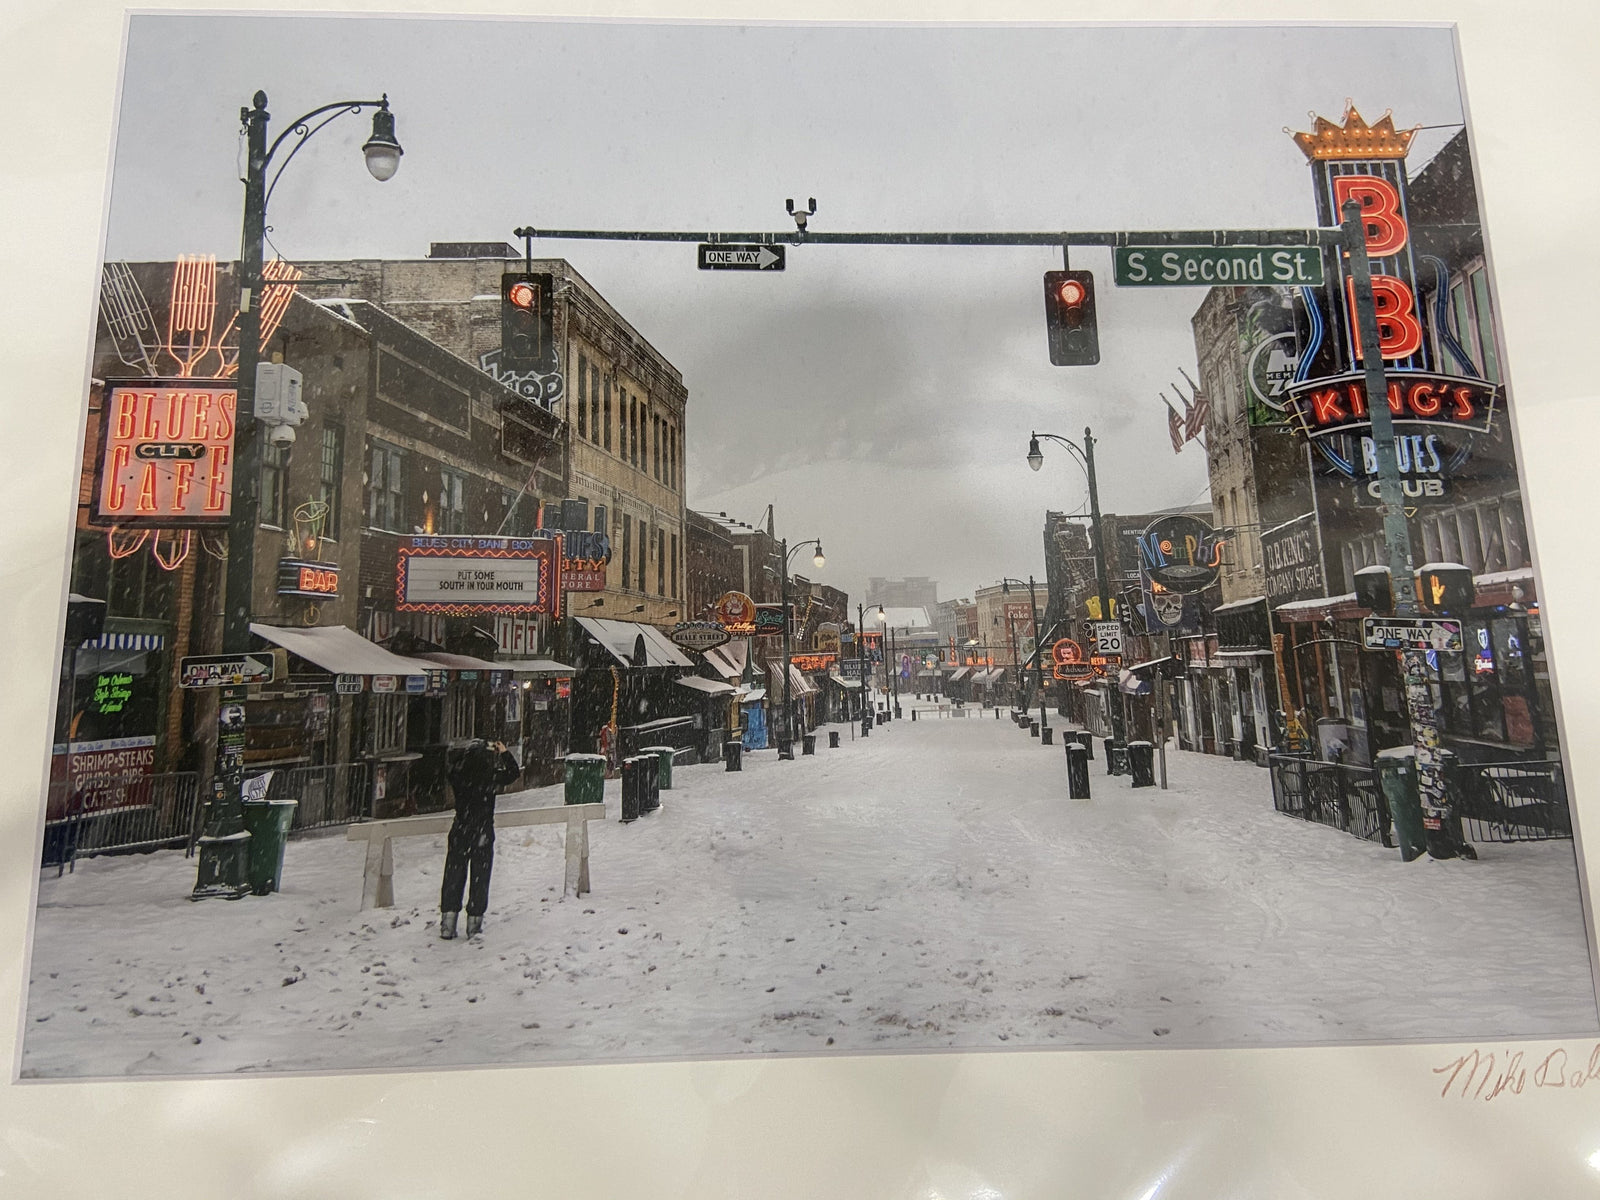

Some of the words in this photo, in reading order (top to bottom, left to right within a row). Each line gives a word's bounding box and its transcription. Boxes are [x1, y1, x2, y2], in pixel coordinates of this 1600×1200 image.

[1332, 174, 1409, 258] B
[708, 252, 732, 263] ONE
[735, 252, 760, 263] WAY
[1127, 252, 1153, 282] S.
[1160, 252, 1263, 282] Second
[1271, 252, 1313, 281] St.
[1346, 274, 1422, 361] B
[1309, 381, 1476, 424] KING'S
[113, 391, 236, 441] BLUES
[138, 444, 203, 457] CITY
[1360, 434, 1442, 475] BUES
[106, 444, 229, 512] CAFE
[1366, 479, 1446, 498] CUB
[411, 537, 448, 548] BLUES
[451, 538, 475, 548] CITY
[478, 539, 508, 549] BAND
[511, 540, 535, 550] BOX
[1136, 529, 1227, 570] Memphis
[1281, 530, 1312, 567] KING'S
[564, 558, 605, 571] ITY
[299, 567, 339, 593] BAR
[439, 580, 465, 591] SOUTH
[476, 581, 494, 591] YOUR
[495, 581, 524, 591] MOUTH
[457, 571, 472, 581] PUT
[474, 571, 495, 581] SOME
[561, 573, 600, 581] NERAL
[561, 580, 592, 589] TORE
[1266, 570, 1296, 598] COMPANY
[1294, 563, 1322, 591] STORE
[1007, 611, 1029, 619] Coke
[502, 623, 537, 651] IFT
[675, 633, 698, 641] BEALE
[698, 632, 724, 641] STREET
[1097, 624, 1120, 632] SPEED
[1376, 627, 1401, 640] ONE
[1406, 628, 1433, 641] WAY
[1099, 638, 1121, 650] 20
[220, 663, 245, 676] WAY
[72, 752, 115, 773] SHRIMP
[118, 749, 155, 768] STEAKS
[75, 770, 111, 792] GUMBO
[83, 787, 128, 810] CATFSH
